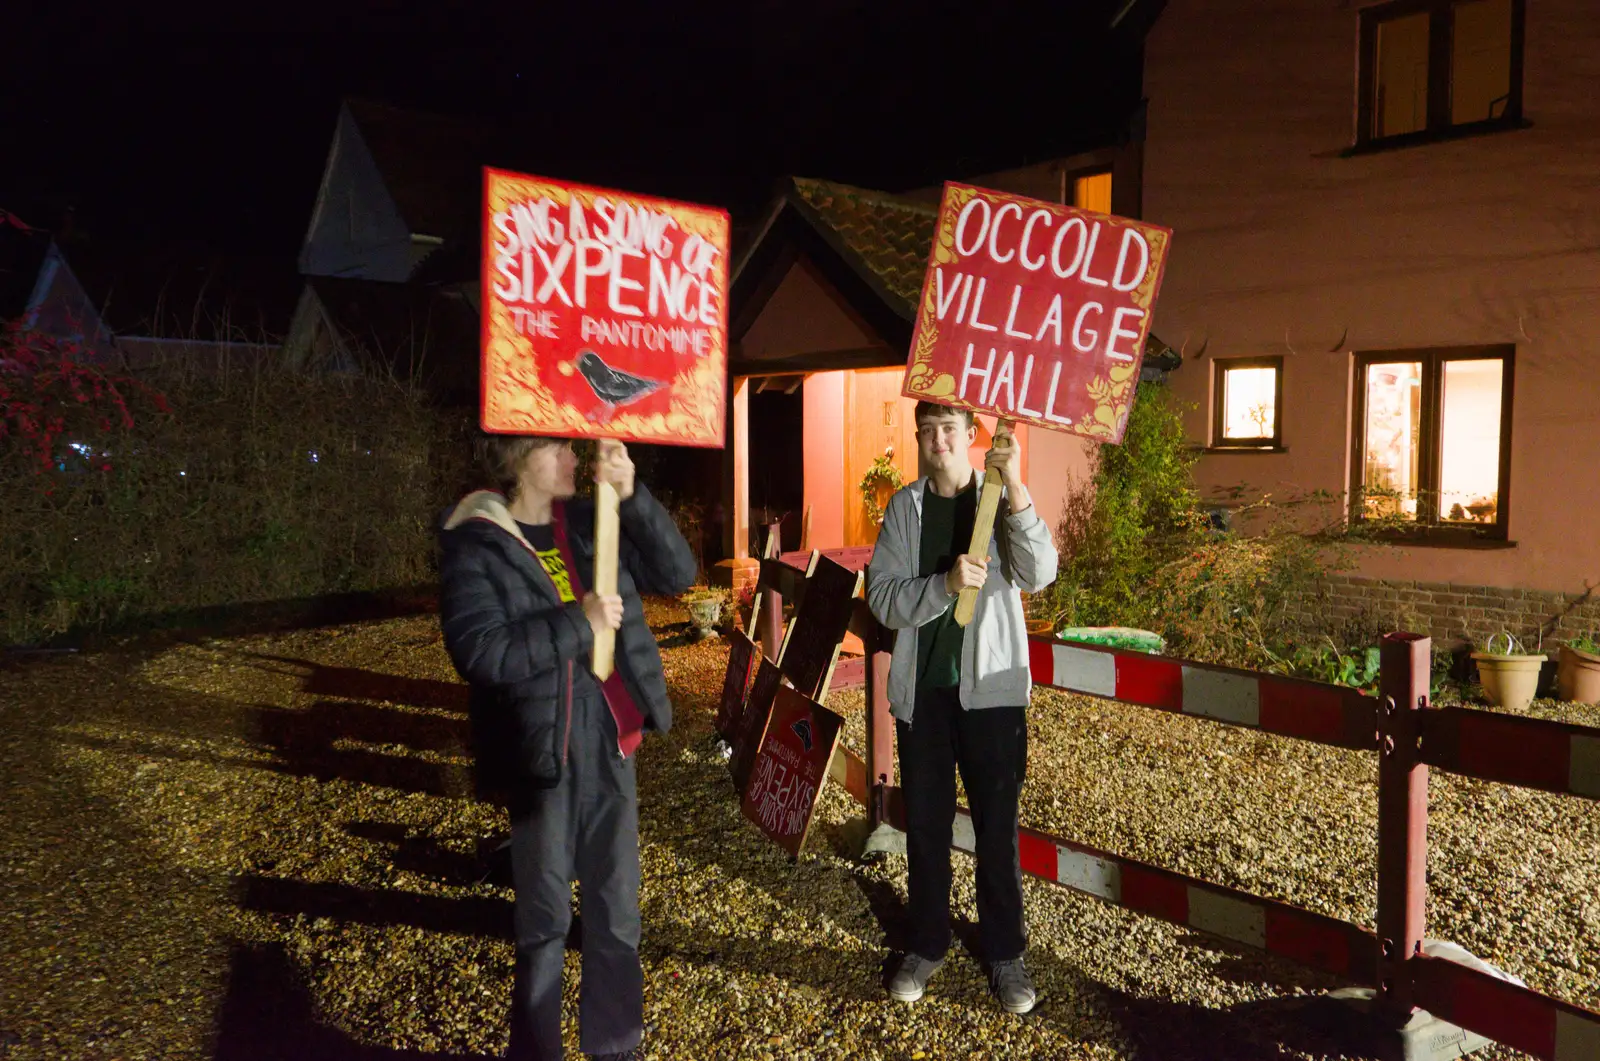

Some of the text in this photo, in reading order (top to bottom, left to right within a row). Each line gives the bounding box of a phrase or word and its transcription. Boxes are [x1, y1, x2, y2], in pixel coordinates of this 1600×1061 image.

[493, 194, 720, 278] SING A SONG OF
[955, 198, 1149, 292] OCCOLD
[493, 238, 719, 327] SIXPENCE
[508, 306, 560, 340] THE
[936, 267, 1145, 361] VILLAGE
[959, 343, 1072, 425] HALL
[757, 751, 815, 809] SIXPENCE
